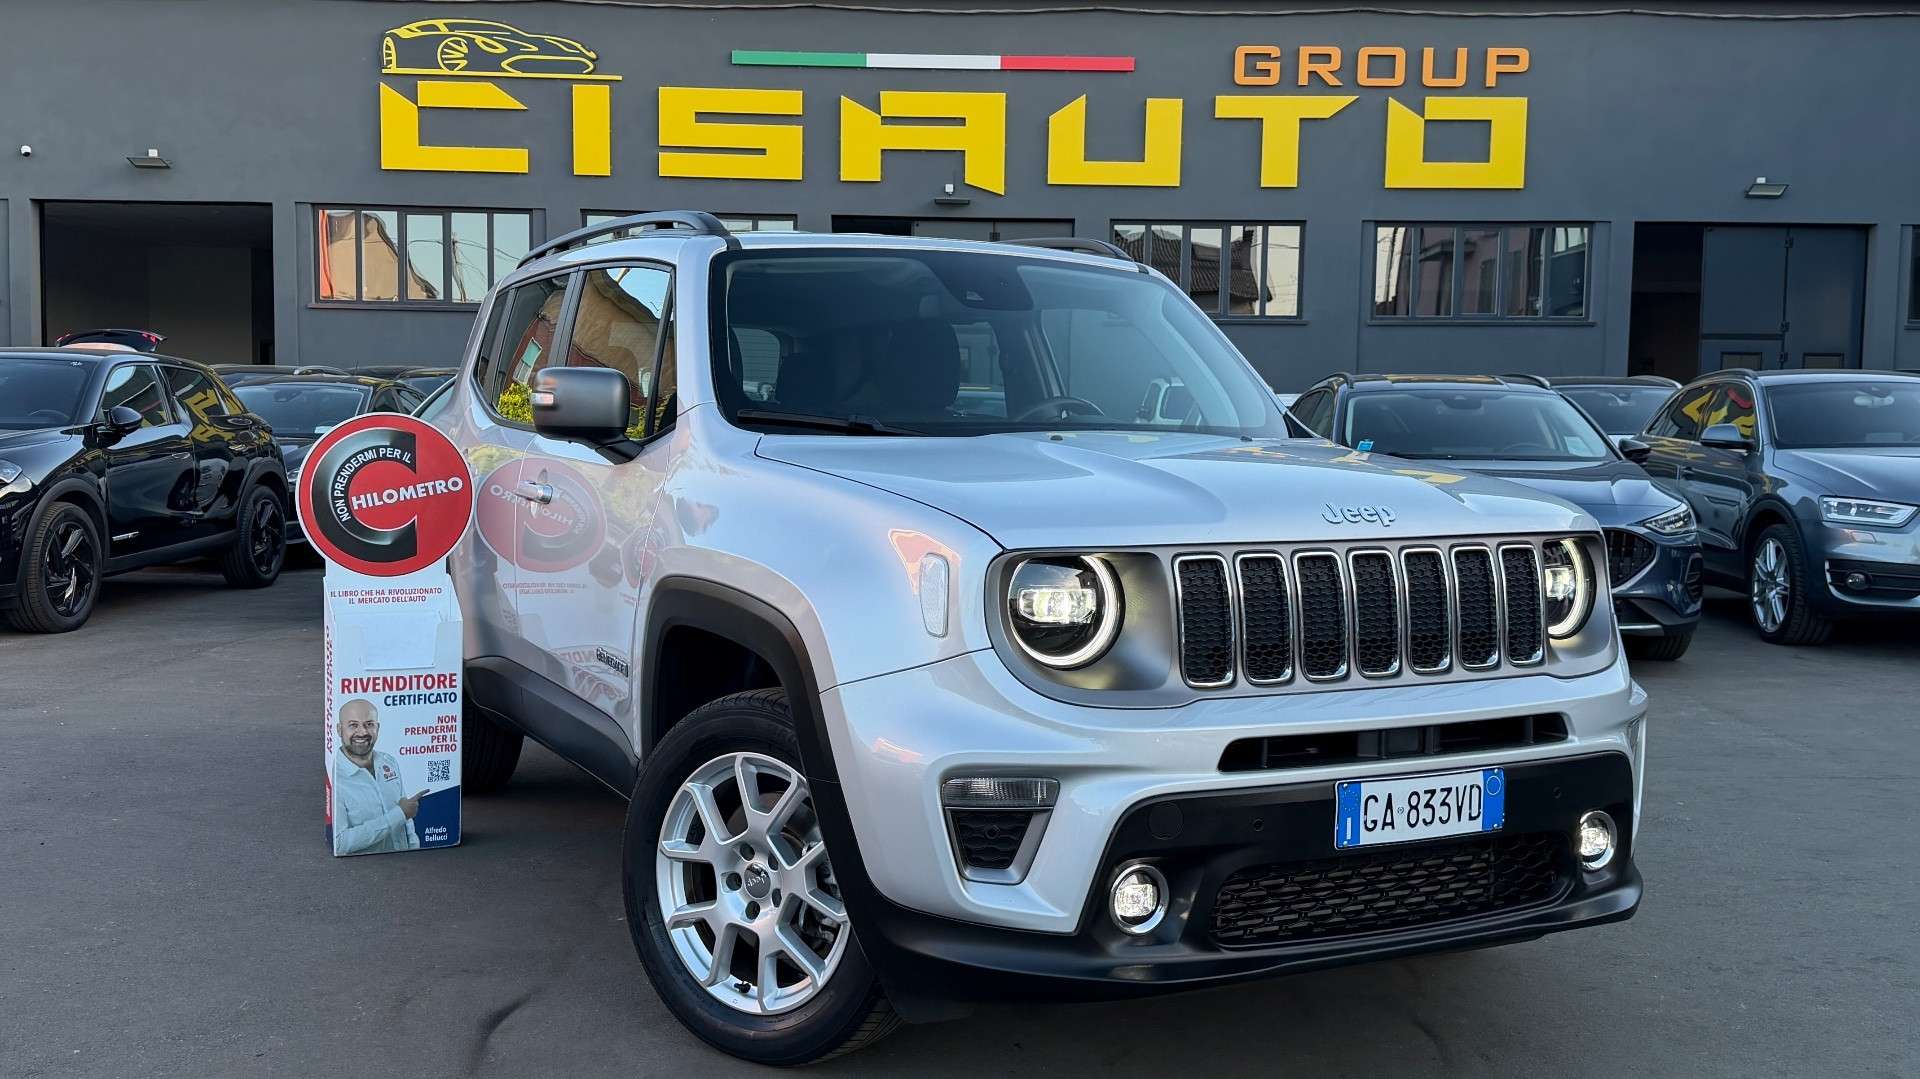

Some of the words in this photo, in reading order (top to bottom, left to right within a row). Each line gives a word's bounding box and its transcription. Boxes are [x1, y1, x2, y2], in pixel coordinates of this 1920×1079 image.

[1234, 45, 1530, 88] GROUP
[379, 80, 1529, 196] CISAUTO
[379, 447, 402, 459] PER
[402, 451, 412, 464] IL
[334, 449, 378, 497] PRENDERMI
[334, 500, 351, 522] NON
[1320, 502, 1398, 528] Jeep
[338, 590, 359, 598] LIBRO
[360, 589, 374, 597] CHE
[375, 589, 386, 597] HA
[388, 587, 442, 596] RIVOLUZIONATO
[349, 597, 356, 605] IL
[357, 596, 391, 605] MERCATO
[391, 595, 427, 604] DELL'AUTO
[340, 673, 458, 695] RIVENDITORE
[384, 692, 458, 707] CERTIFICATO
[437, 714, 457, 724] NON
[404, 725, 457, 736] PRENDERMI
[431, 736, 448, 744] PER
[450, 735, 457, 743] IL
[400, 743, 457, 755] CHILOMETRO
[425, 826, 447, 834] Alfredo
[425, 833, 448, 842] Bellucci
